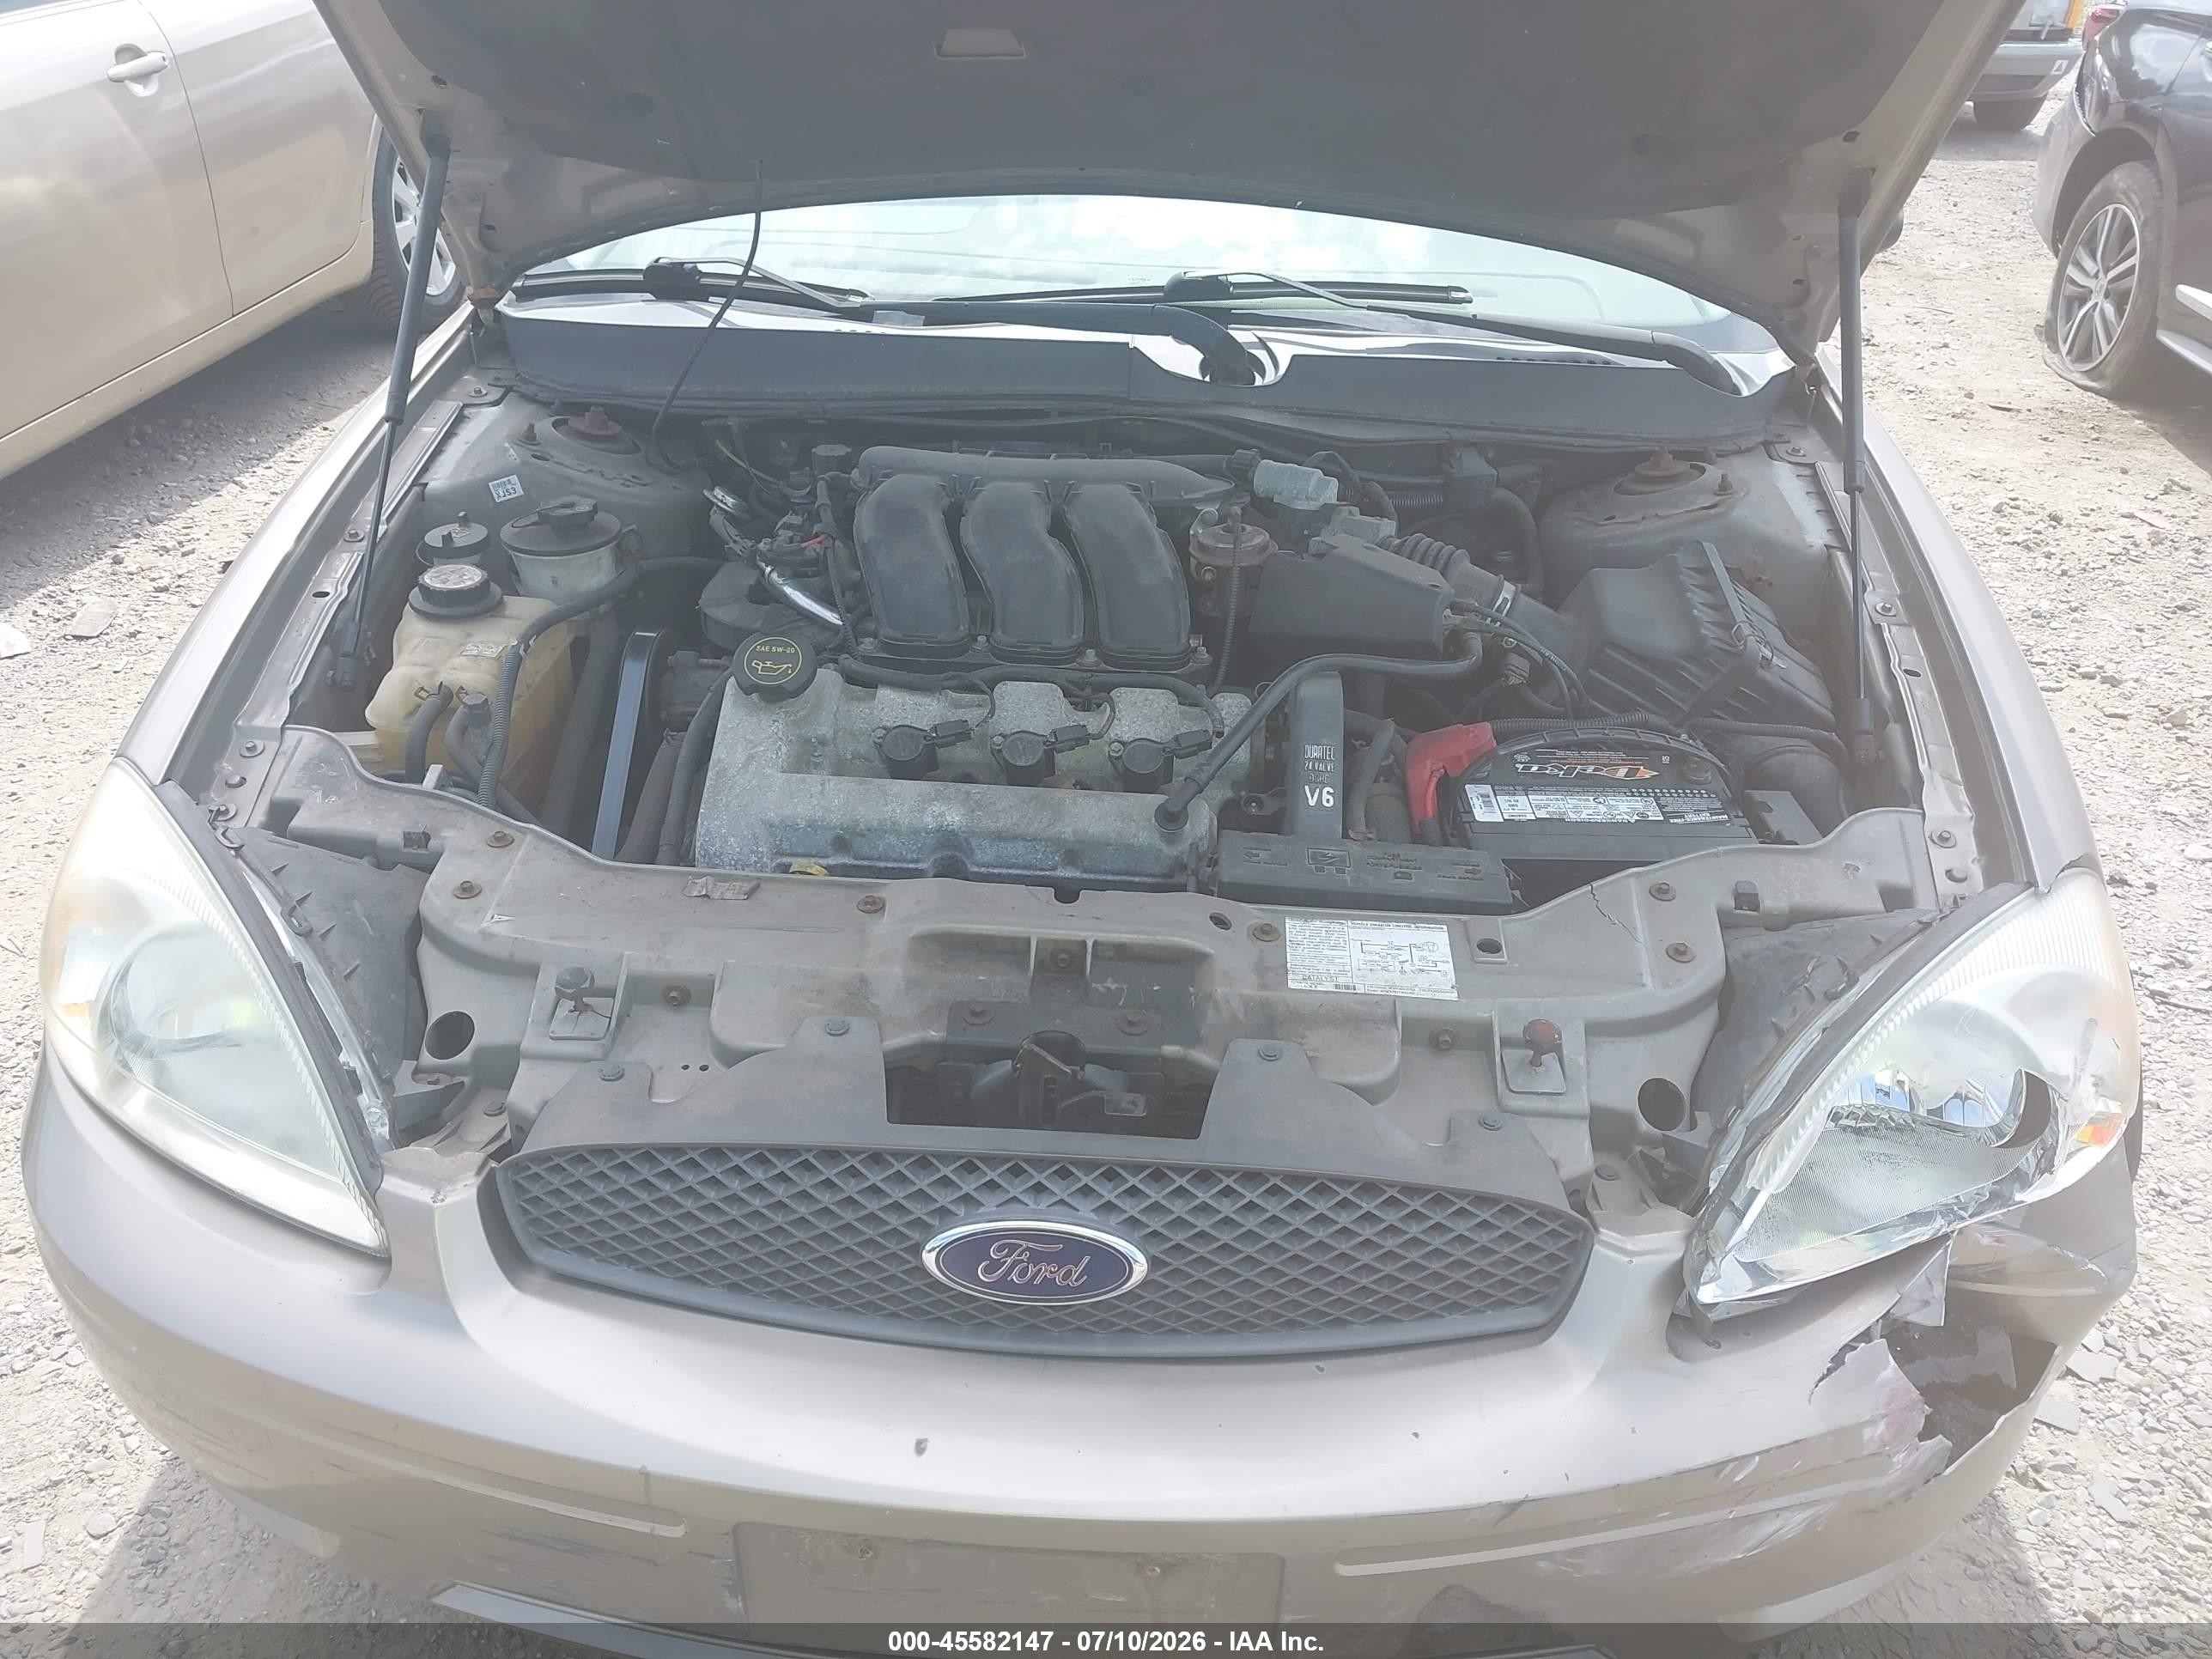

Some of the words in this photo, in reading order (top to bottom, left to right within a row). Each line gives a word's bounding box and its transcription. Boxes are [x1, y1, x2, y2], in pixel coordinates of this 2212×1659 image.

[1304, 744, 1335, 761] DURATEC
[1304, 761, 1312, 770] 24
[1315, 762, 1334, 772] VALVE
[1516, 763, 1659, 780] Deka
[1304, 785, 1334, 807] V6
[977, 1239, 1091, 1287] Ford
